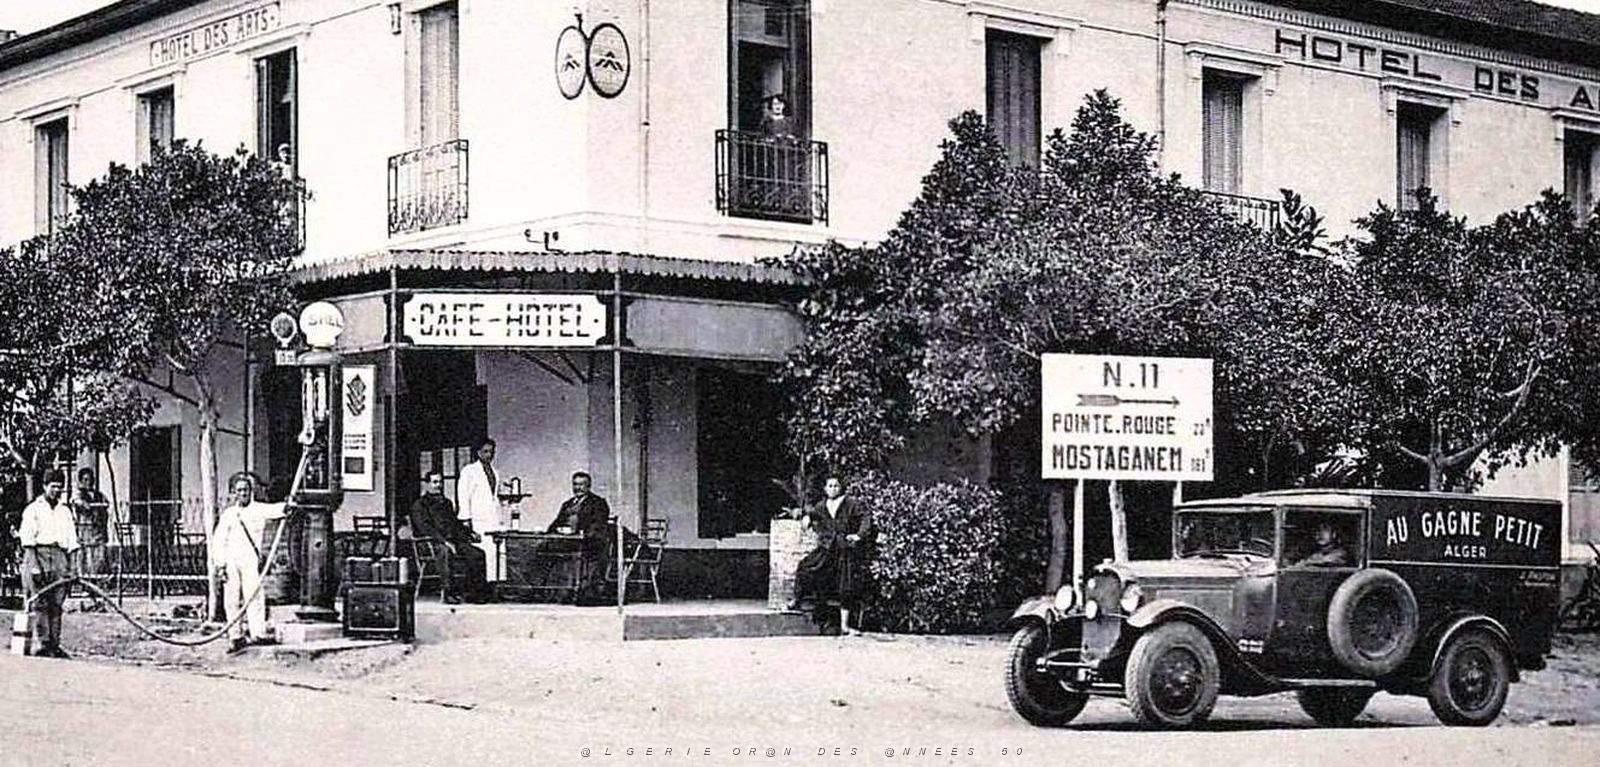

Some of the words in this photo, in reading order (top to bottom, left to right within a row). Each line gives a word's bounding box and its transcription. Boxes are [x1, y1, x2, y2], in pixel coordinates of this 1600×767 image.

[161, 32, 198, 63] HOTEL
[204, 22, 229, 50] DES
[237, 9, 268, 40] ARTS
[1275, 29, 1442, 81] HOTEL
[1474, 66, 1540, 100] DES
[1570, 85, 1600, 111] A
[1052, 444, 1183, 472] MOSTAGANEM
[1386, 515, 1409, 547] AU
[1421, 511, 1482, 538] GAGNE
[1494, 514, 1544, 549] PETIT
[1444, 544, 1487, 559] ALGER
